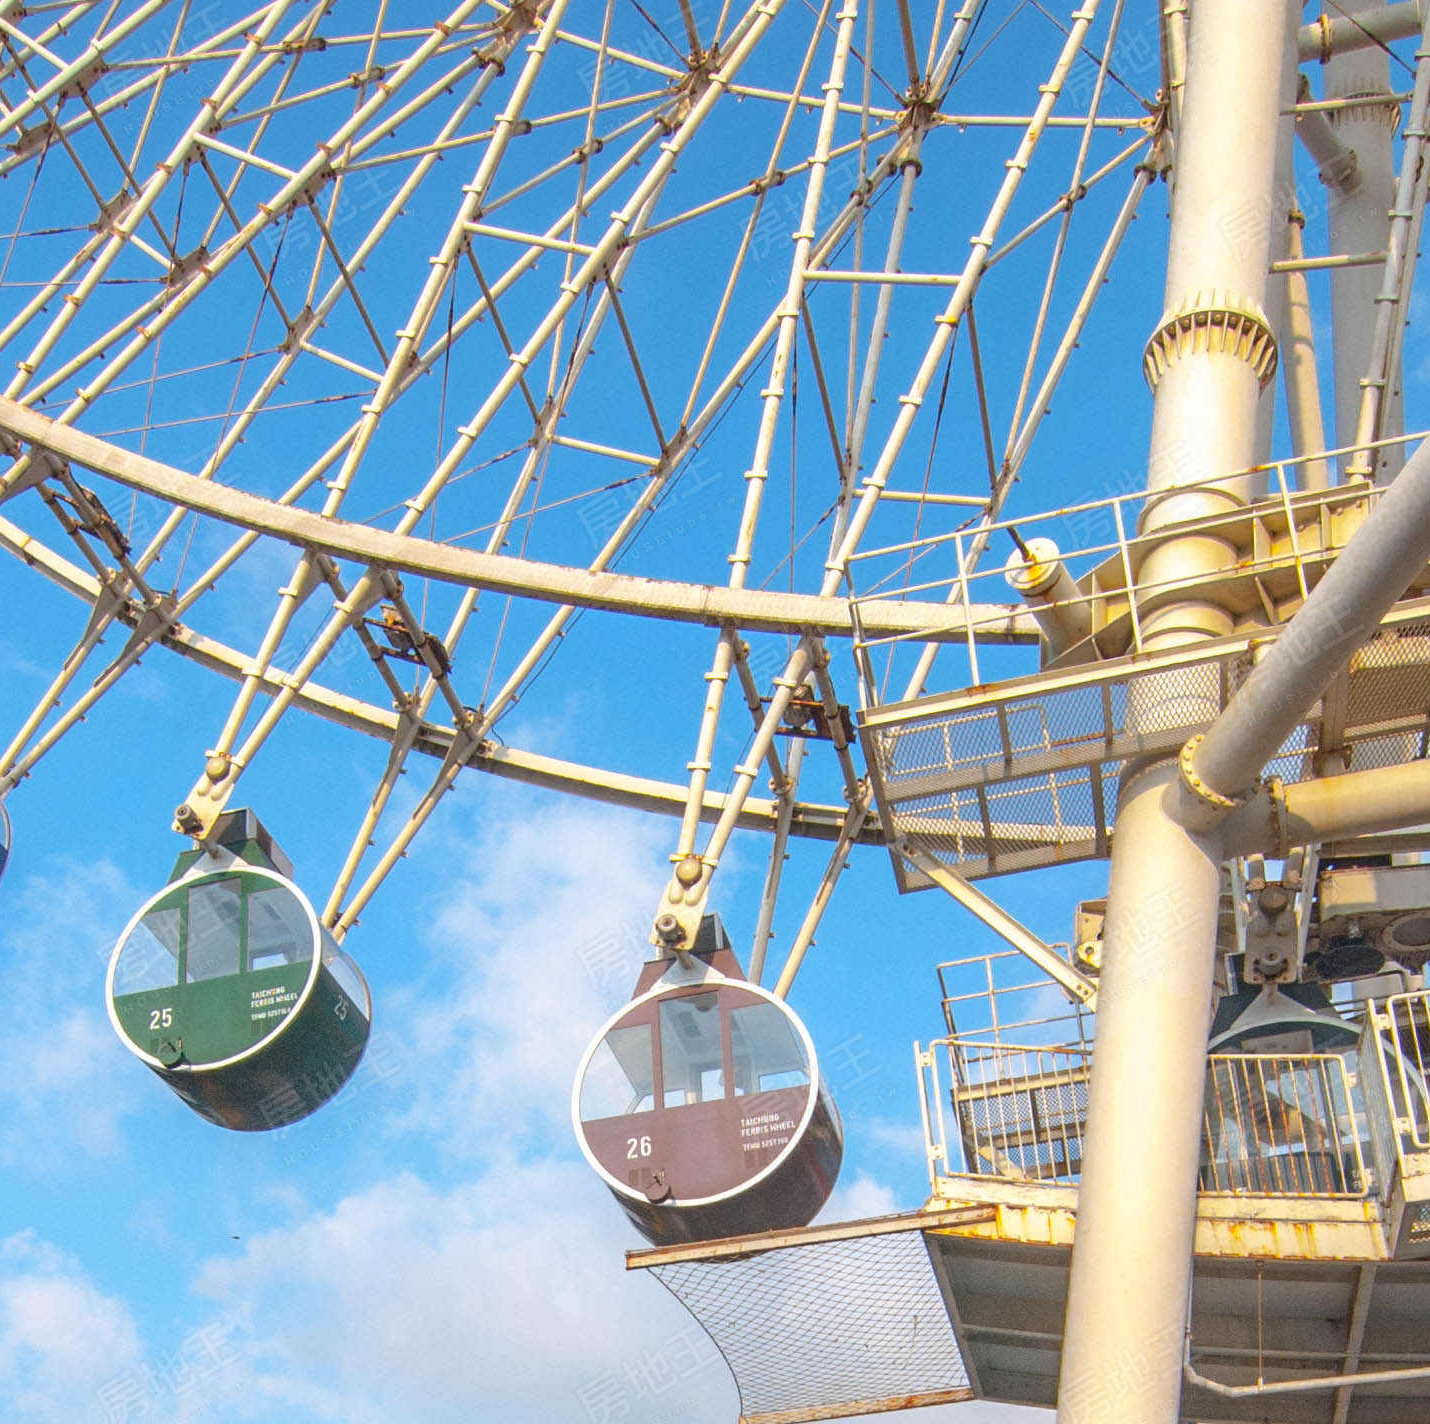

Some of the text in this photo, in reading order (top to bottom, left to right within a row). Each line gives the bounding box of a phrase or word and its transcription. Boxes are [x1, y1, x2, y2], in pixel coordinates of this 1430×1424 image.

[149, 1008, 173, 1030] 25
[334, 995, 349, 1021] 25
[769, 1120, 796, 1133] WHEEL
[626, 1135, 652, 1160] 26
